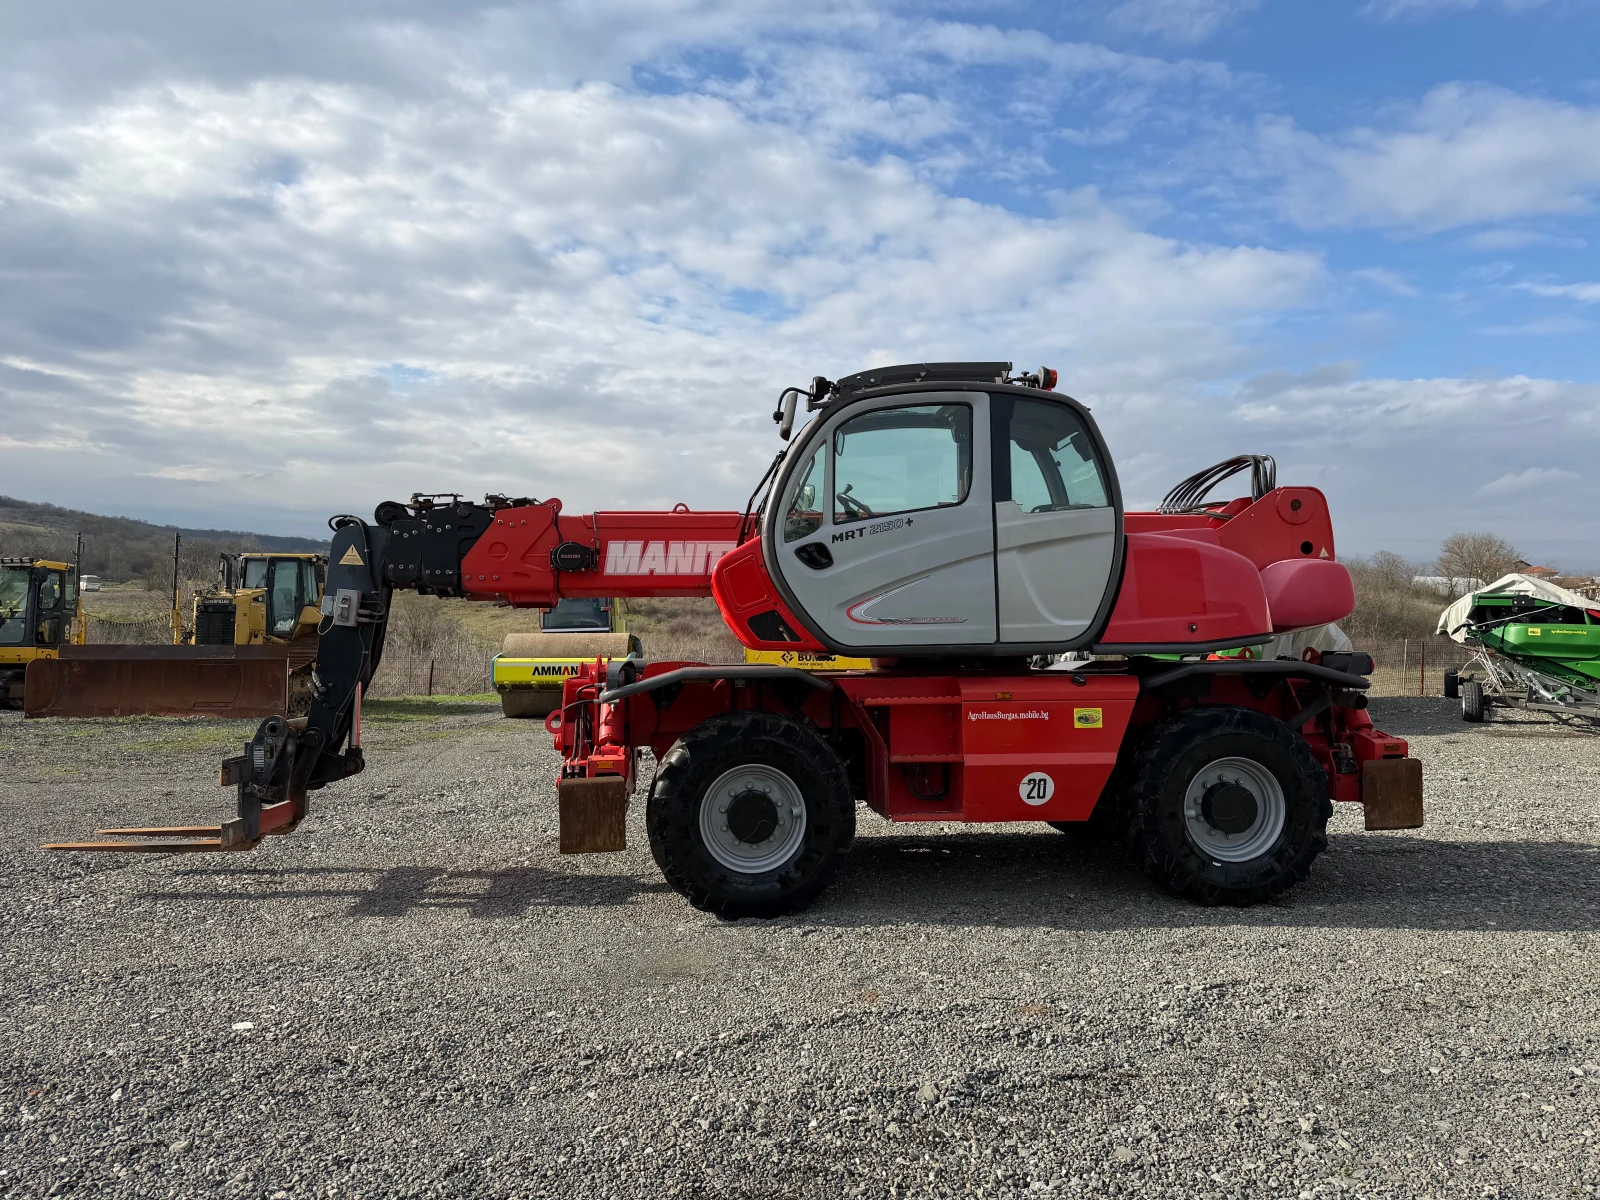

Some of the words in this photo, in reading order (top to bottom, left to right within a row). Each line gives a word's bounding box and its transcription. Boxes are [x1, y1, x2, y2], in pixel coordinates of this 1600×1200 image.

[832, 527, 867, 544] MRT
[968, 711, 1049, 721] AgroHausBurgas.mobile.bg
[1026, 778, 1047, 800] 20
